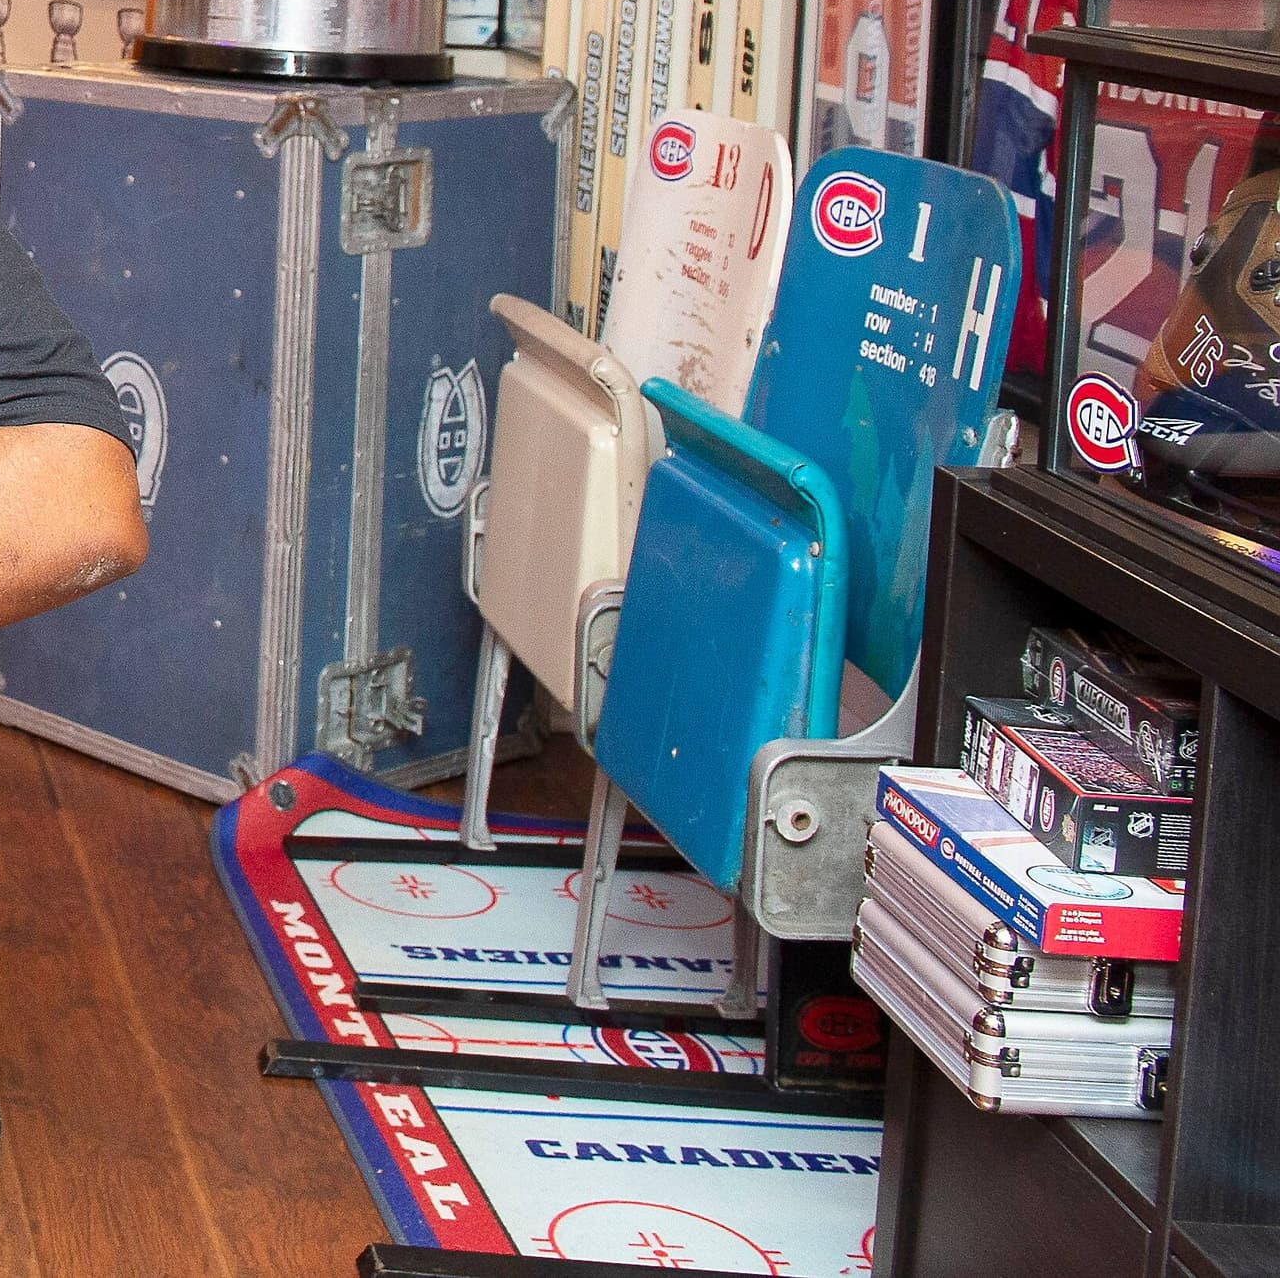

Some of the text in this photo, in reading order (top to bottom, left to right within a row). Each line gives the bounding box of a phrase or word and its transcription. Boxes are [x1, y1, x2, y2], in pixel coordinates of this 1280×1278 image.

[575, 30, 605, 214] SHERWOOD
[709, 142, 742, 190] 13
[746, 161, 773, 260] D
[908, 201, 932, 262] 1
[870, 283, 918, 315] number
[951, 255, 1002, 392] H
[864, 311, 935, 354] row H
[1177, 314, 1224, 388] 76
[859, 338, 938, 388] section 418
[1138, 419, 1191, 446] CCM
[1078, 677, 1128, 730] CHECKERS
[887, 793, 938, 843] MONOPOLY
[268, 897, 473, 1224] MONTEAL
[524, 1137, 884, 1178] CANADIEN
